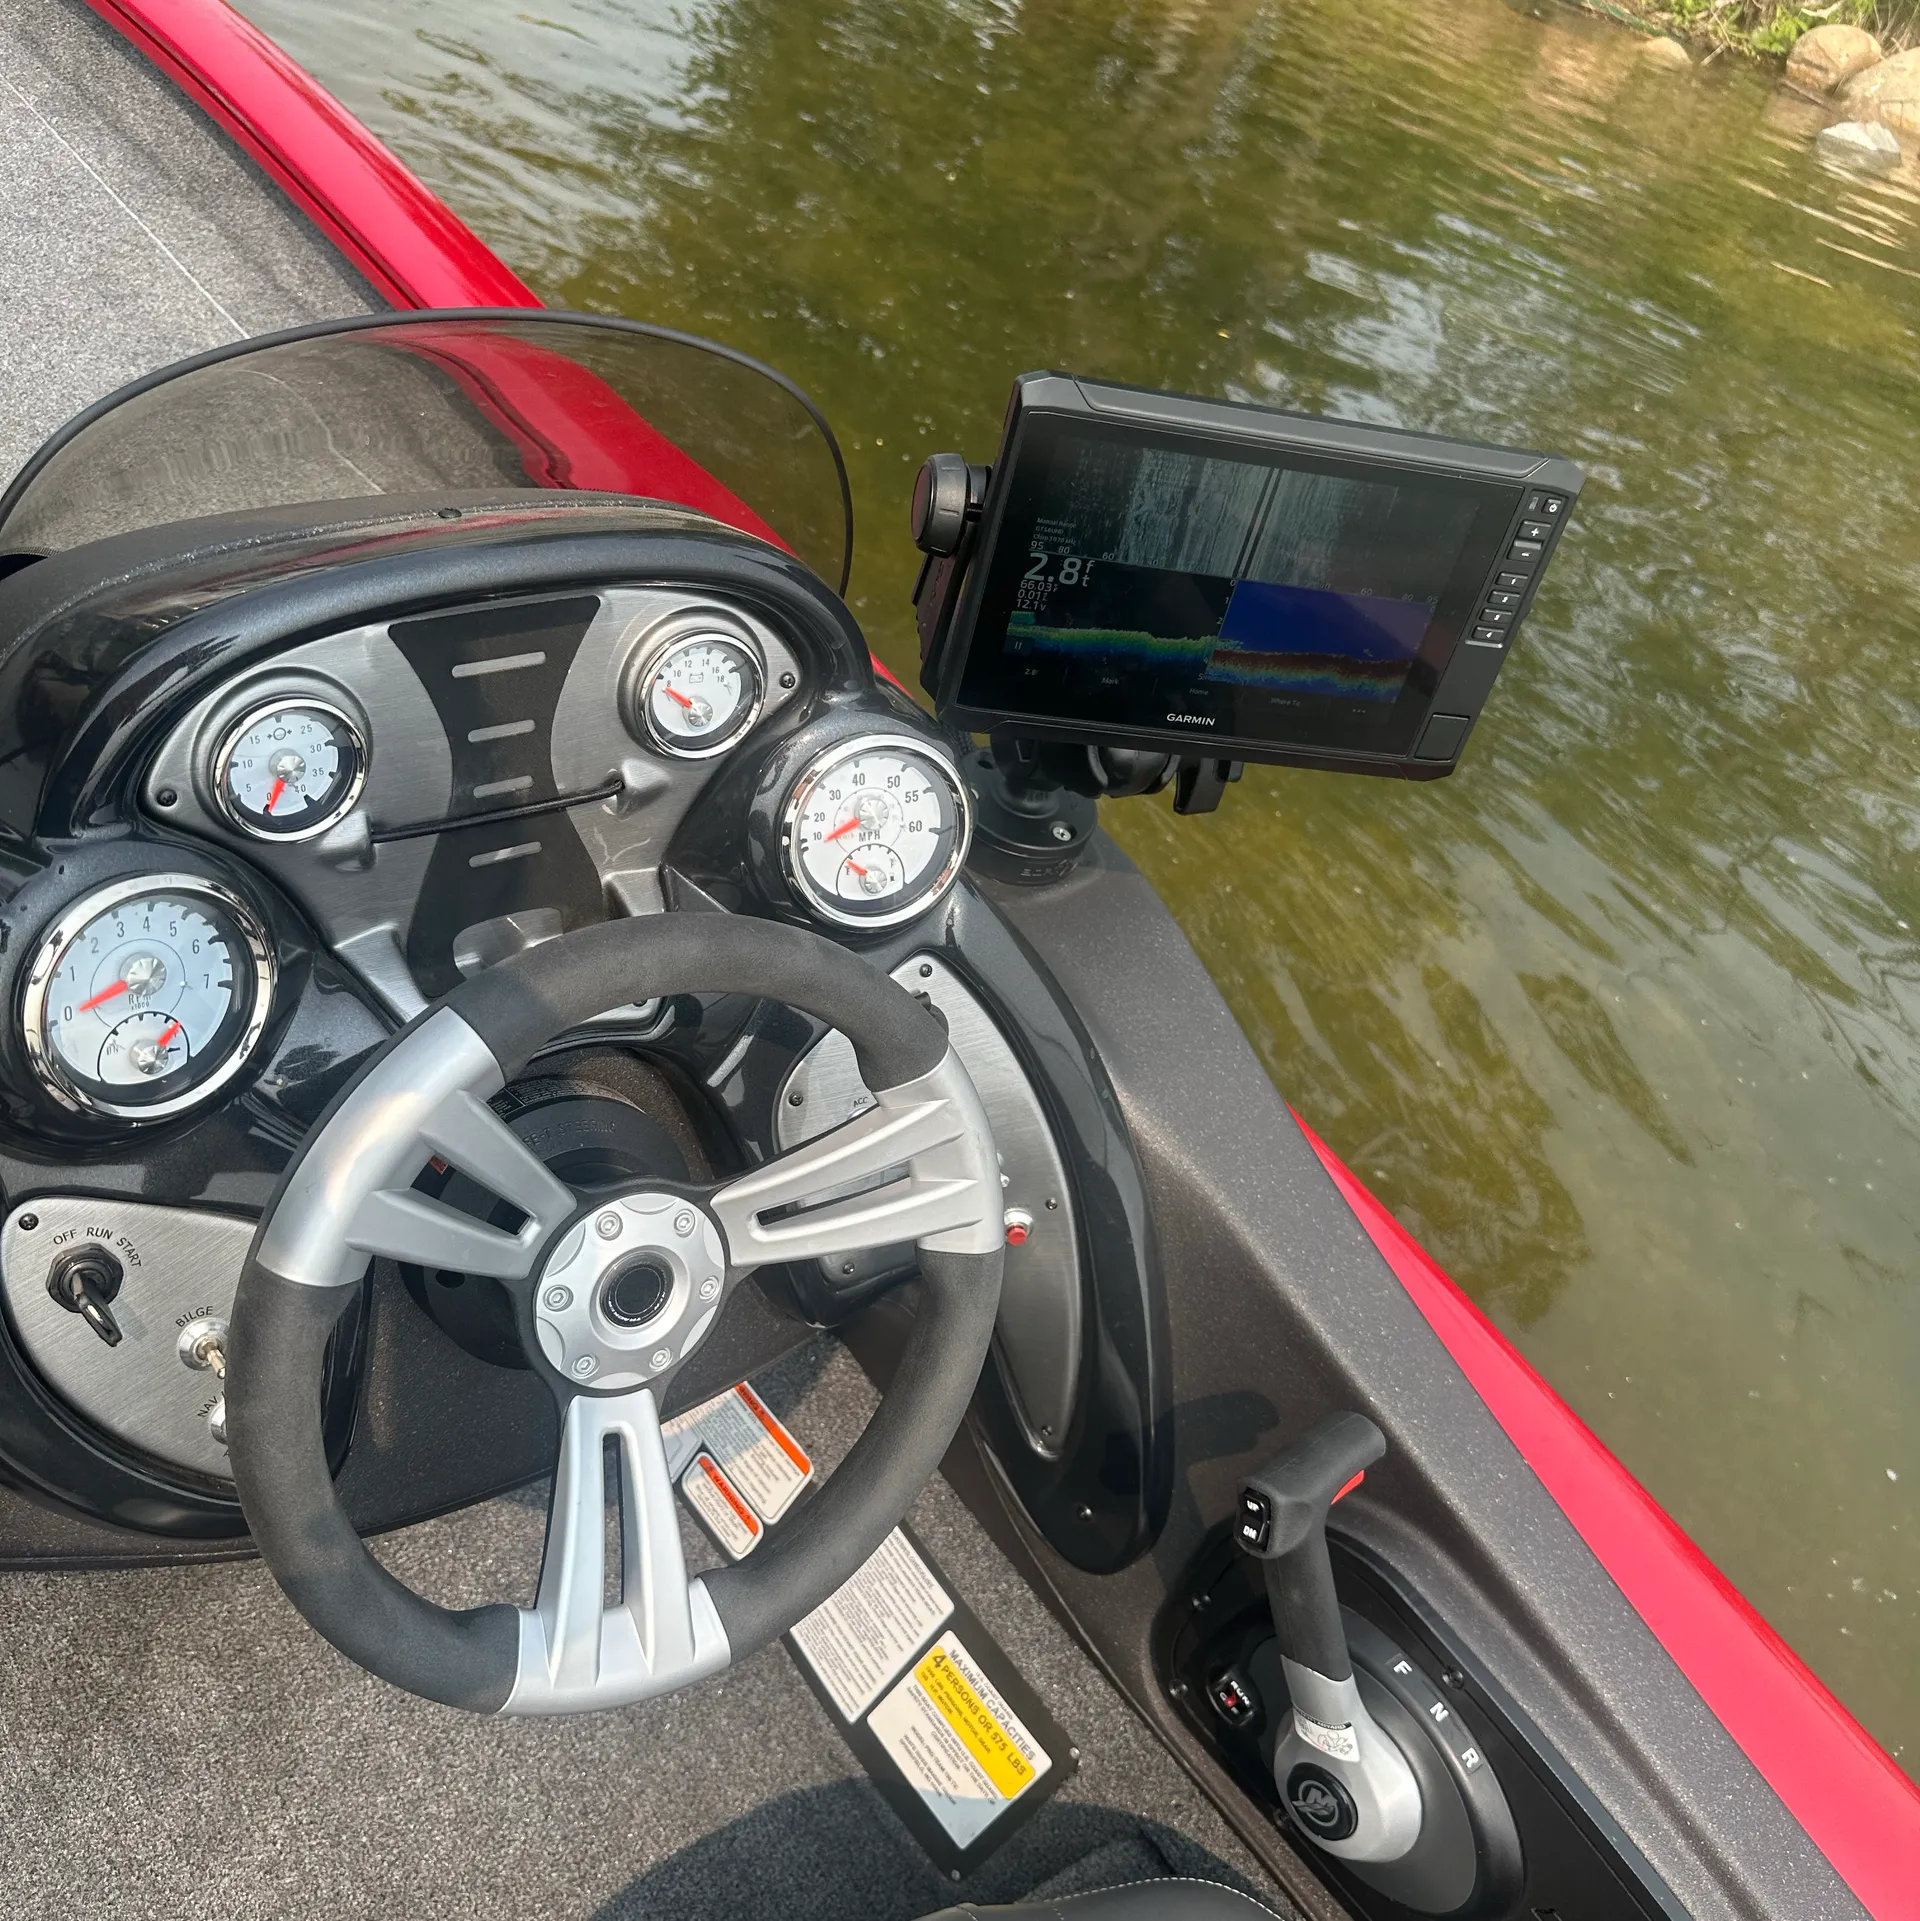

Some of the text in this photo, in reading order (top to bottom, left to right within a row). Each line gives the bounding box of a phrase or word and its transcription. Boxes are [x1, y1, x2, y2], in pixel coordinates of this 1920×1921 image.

[1031, 541, 1044, 550] 95
[1058, 546, 1070, 554] 80
[1102, 552, 1114, 560] 60
[1024, 552, 1082, 585] 2.8
[1360, 588, 1373, 596] 60
[684, 660, 692, 668] 12
[702, 659, 710, 667] 14
[717, 675, 725, 683] 18
[1166, 713, 1216, 727] GARMIN
[300, 725, 313, 735] 25
[250, 735, 261, 745] 15
[310, 743, 322, 753] 30
[242, 759, 253, 769] 10
[312, 769, 324, 777] 35
[852, 773, 866, 786] 40
[246, 783, 252, 793] 5
[887, 775, 901, 788] 50
[294, 784, 306, 794] 40
[829, 789, 841, 801] 30
[266, 792, 272, 801] 0
[905, 790, 919, 803] 55
[814, 812, 826, 822] 20
[908, 820, 923, 833] 60
[813, 831, 822, 841] 10
[858, 830, 881, 842] MPH
[116, 921, 125, 937] 3
[142, 916, 151, 932] 4
[169, 921, 178, 937] 5
[90, 937, 99, 954] 2
[192, 939, 200, 954] 6
[70, 966, 76, 982] 1
[203, 973, 211, 989] 7
[63, 1005, 73, 1021] 0
[853, 1096, 869, 1108] ACC
[53, 1227, 142, 1268] OFF RUN START
[176, 1305, 214, 1328] BILGE
[197, 1395, 218, 1418] NAV
[1245, 1500, 1260, 1513] UP
[1242, 1524, 1258, 1540] DN
[1393, 1660, 1412, 1677] F
[1231, 1680, 1251, 1706] RUN
[947, 1649, 1037, 1762] MAXIMUM CAPACITIES
[1430, 1702, 1449, 1722] N
[932, 1653, 1027, 1776] 4 PERSONS OR 575 LBS
[1462, 1747, 1479, 1768] R
